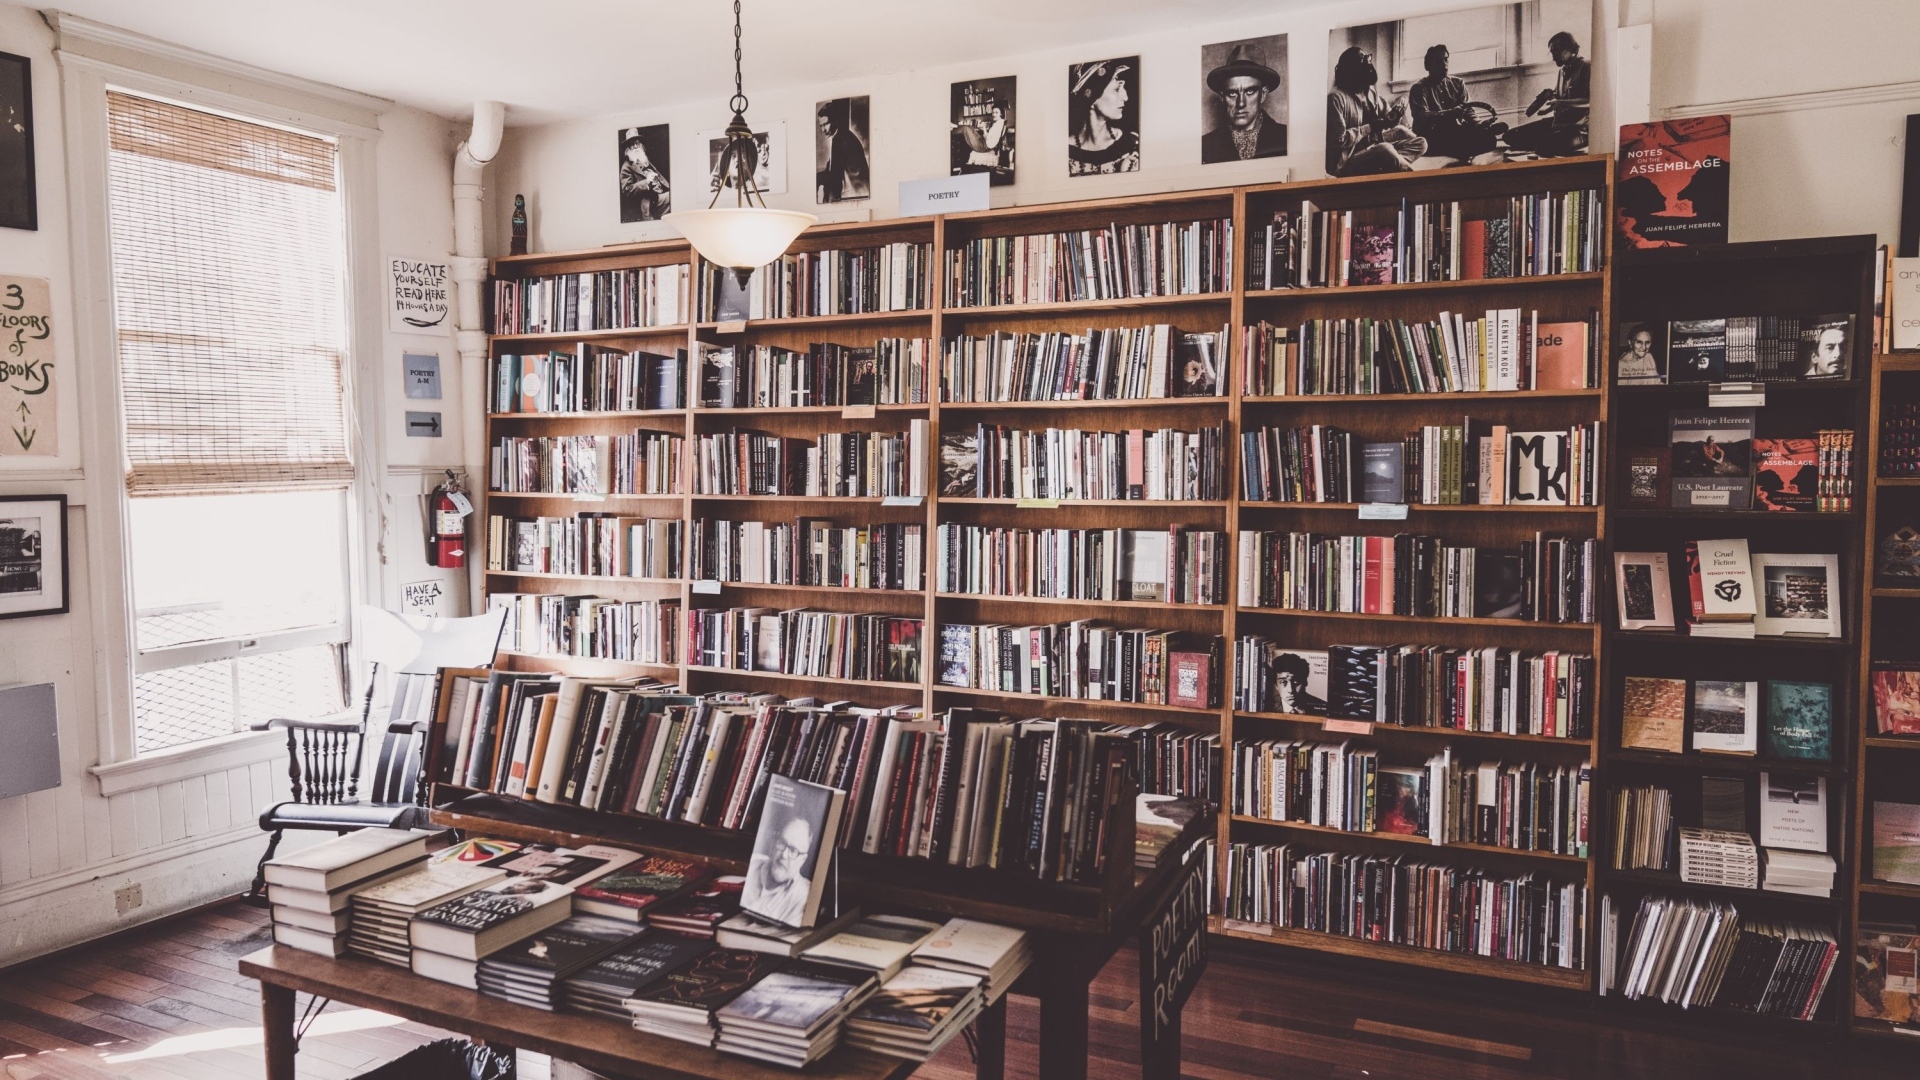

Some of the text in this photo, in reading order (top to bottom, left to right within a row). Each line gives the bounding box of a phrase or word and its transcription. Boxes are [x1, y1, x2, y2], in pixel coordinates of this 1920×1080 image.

[1627, 149, 1662, 158] NOTES
[1629, 158, 1721, 175] ASSEMBLAGE
[928, 191, 960, 200] POETRY
[392, 260, 446, 279] EDUCATE
[393, 273, 443, 288] YOURSELF
[2, 284, 24, 310] 3
[396, 288, 447, 302] READ HERE
[406, 301, 428, 312] HOURS
[429, 303, 435, 312] A
[436, 303, 449, 313] DAY
[9, 329, 27, 356] of
[1501, 319, 1509, 356] KENNETH
[0, 359, 54, 395] BOOKS
[1674, 417, 1692, 426] Juan
[1694, 417, 1718, 426] Felipe
[1441, 429, 1449, 440] lally
[1452, 429, 1461, 440] lally
[1714, 550, 1734, 558] Cruel
[405, 582, 442, 601] HAVE A
[411, 594, 437, 607] SEAT
[759, 750, 776, 788] Where Now
[1277, 761, 1285, 803] MACHADO
[1152, 852, 1206, 980] POETRY
